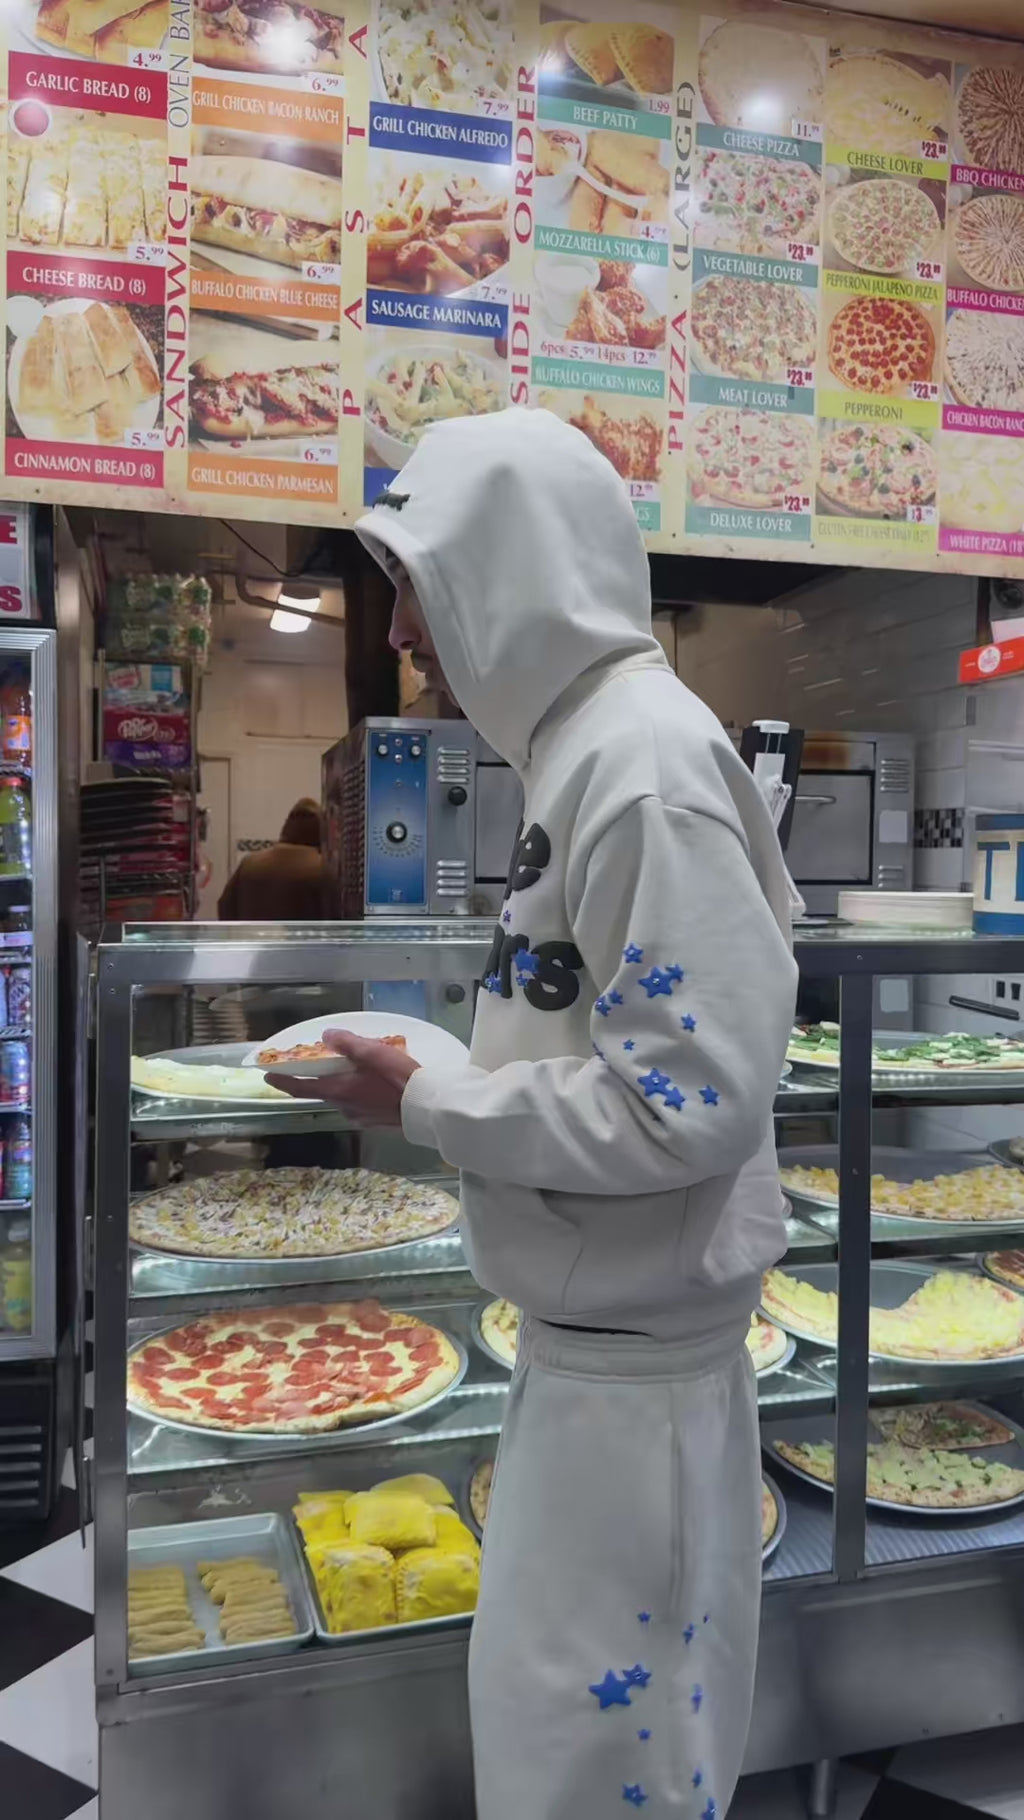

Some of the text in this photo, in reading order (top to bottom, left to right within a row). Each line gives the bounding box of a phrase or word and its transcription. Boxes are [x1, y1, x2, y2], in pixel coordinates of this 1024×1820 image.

[132, 52, 163, 68] 4.99
[25, 71, 151, 103] GARLIC BREAD (8)
[169, 53, 190, 128] OVEN
[312, 77, 340, 92] 6.99
[192, 90, 339, 125] GRILL CHICKEN BACON RANCH
[482, 101, 509, 116] 7.99
[573, 105, 639, 130] BEEF PATTY
[650, 100, 670, 113] 1.99
[372, 115, 508, 148] GRILL CHICKEN ALFREDO
[723, 131, 801, 157] CHEESE PIZZA
[514, 65, 536, 244] ORDER
[847, 151, 924, 175] CHEESE LOVER
[674, 81, 696, 272] (LARGE)
[955, 168, 980, 184] BBQ
[135, 246, 164, 261] 5.99
[538, 231, 611, 254] MOZZARELLA
[614, 242, 644, 260] STICK
[22, 266, 147, 296] CHEESE BREAD (8)
[306, 265, 335, 280] 6.99
[703, 255, 803, 283] VEGETABLE LOVER
[191, 279, 338, 310] BUFFALO CHICKEN BLUE CHEESE
[825, 273, 872, 290] PEPPERONI
[914, 286, 938, 300] PIZZA
[165, 156, 189, 449] SANDWICH
[947, 289, 1024, 311] BUFFALO CHICKE
[371, 300, 502, 329] SAUSAGE MARINARA
[510, 292, 531, 405] SIDE
[540, 341, 564, 357] 6pcs
[569, 346, 595, 360] 5.99
[535, 366, 661, 394] BUFFALO CHICKEN WINGS
[668, 309, 687, 451] PIZZA
[718, 387, 788, 408] MEAT LOVER
[844, 402, 903, 420] PEPPERONI
[946, 410, 979, 427] CHICKEN
[979, 414, 1005, 430] BACON
[131, 432, 160, 447] 5.99
[14, 453, 156, 480] CINNAMON BREAD (8)
[191, 467, 334, 495] GRILL CHICKEN PARMESAN
[709, 512, 792, 532] DELUXE LOVER
[949, 534, 980, 549] WHITE
[981, 537, 1007, 552] PIZZA
